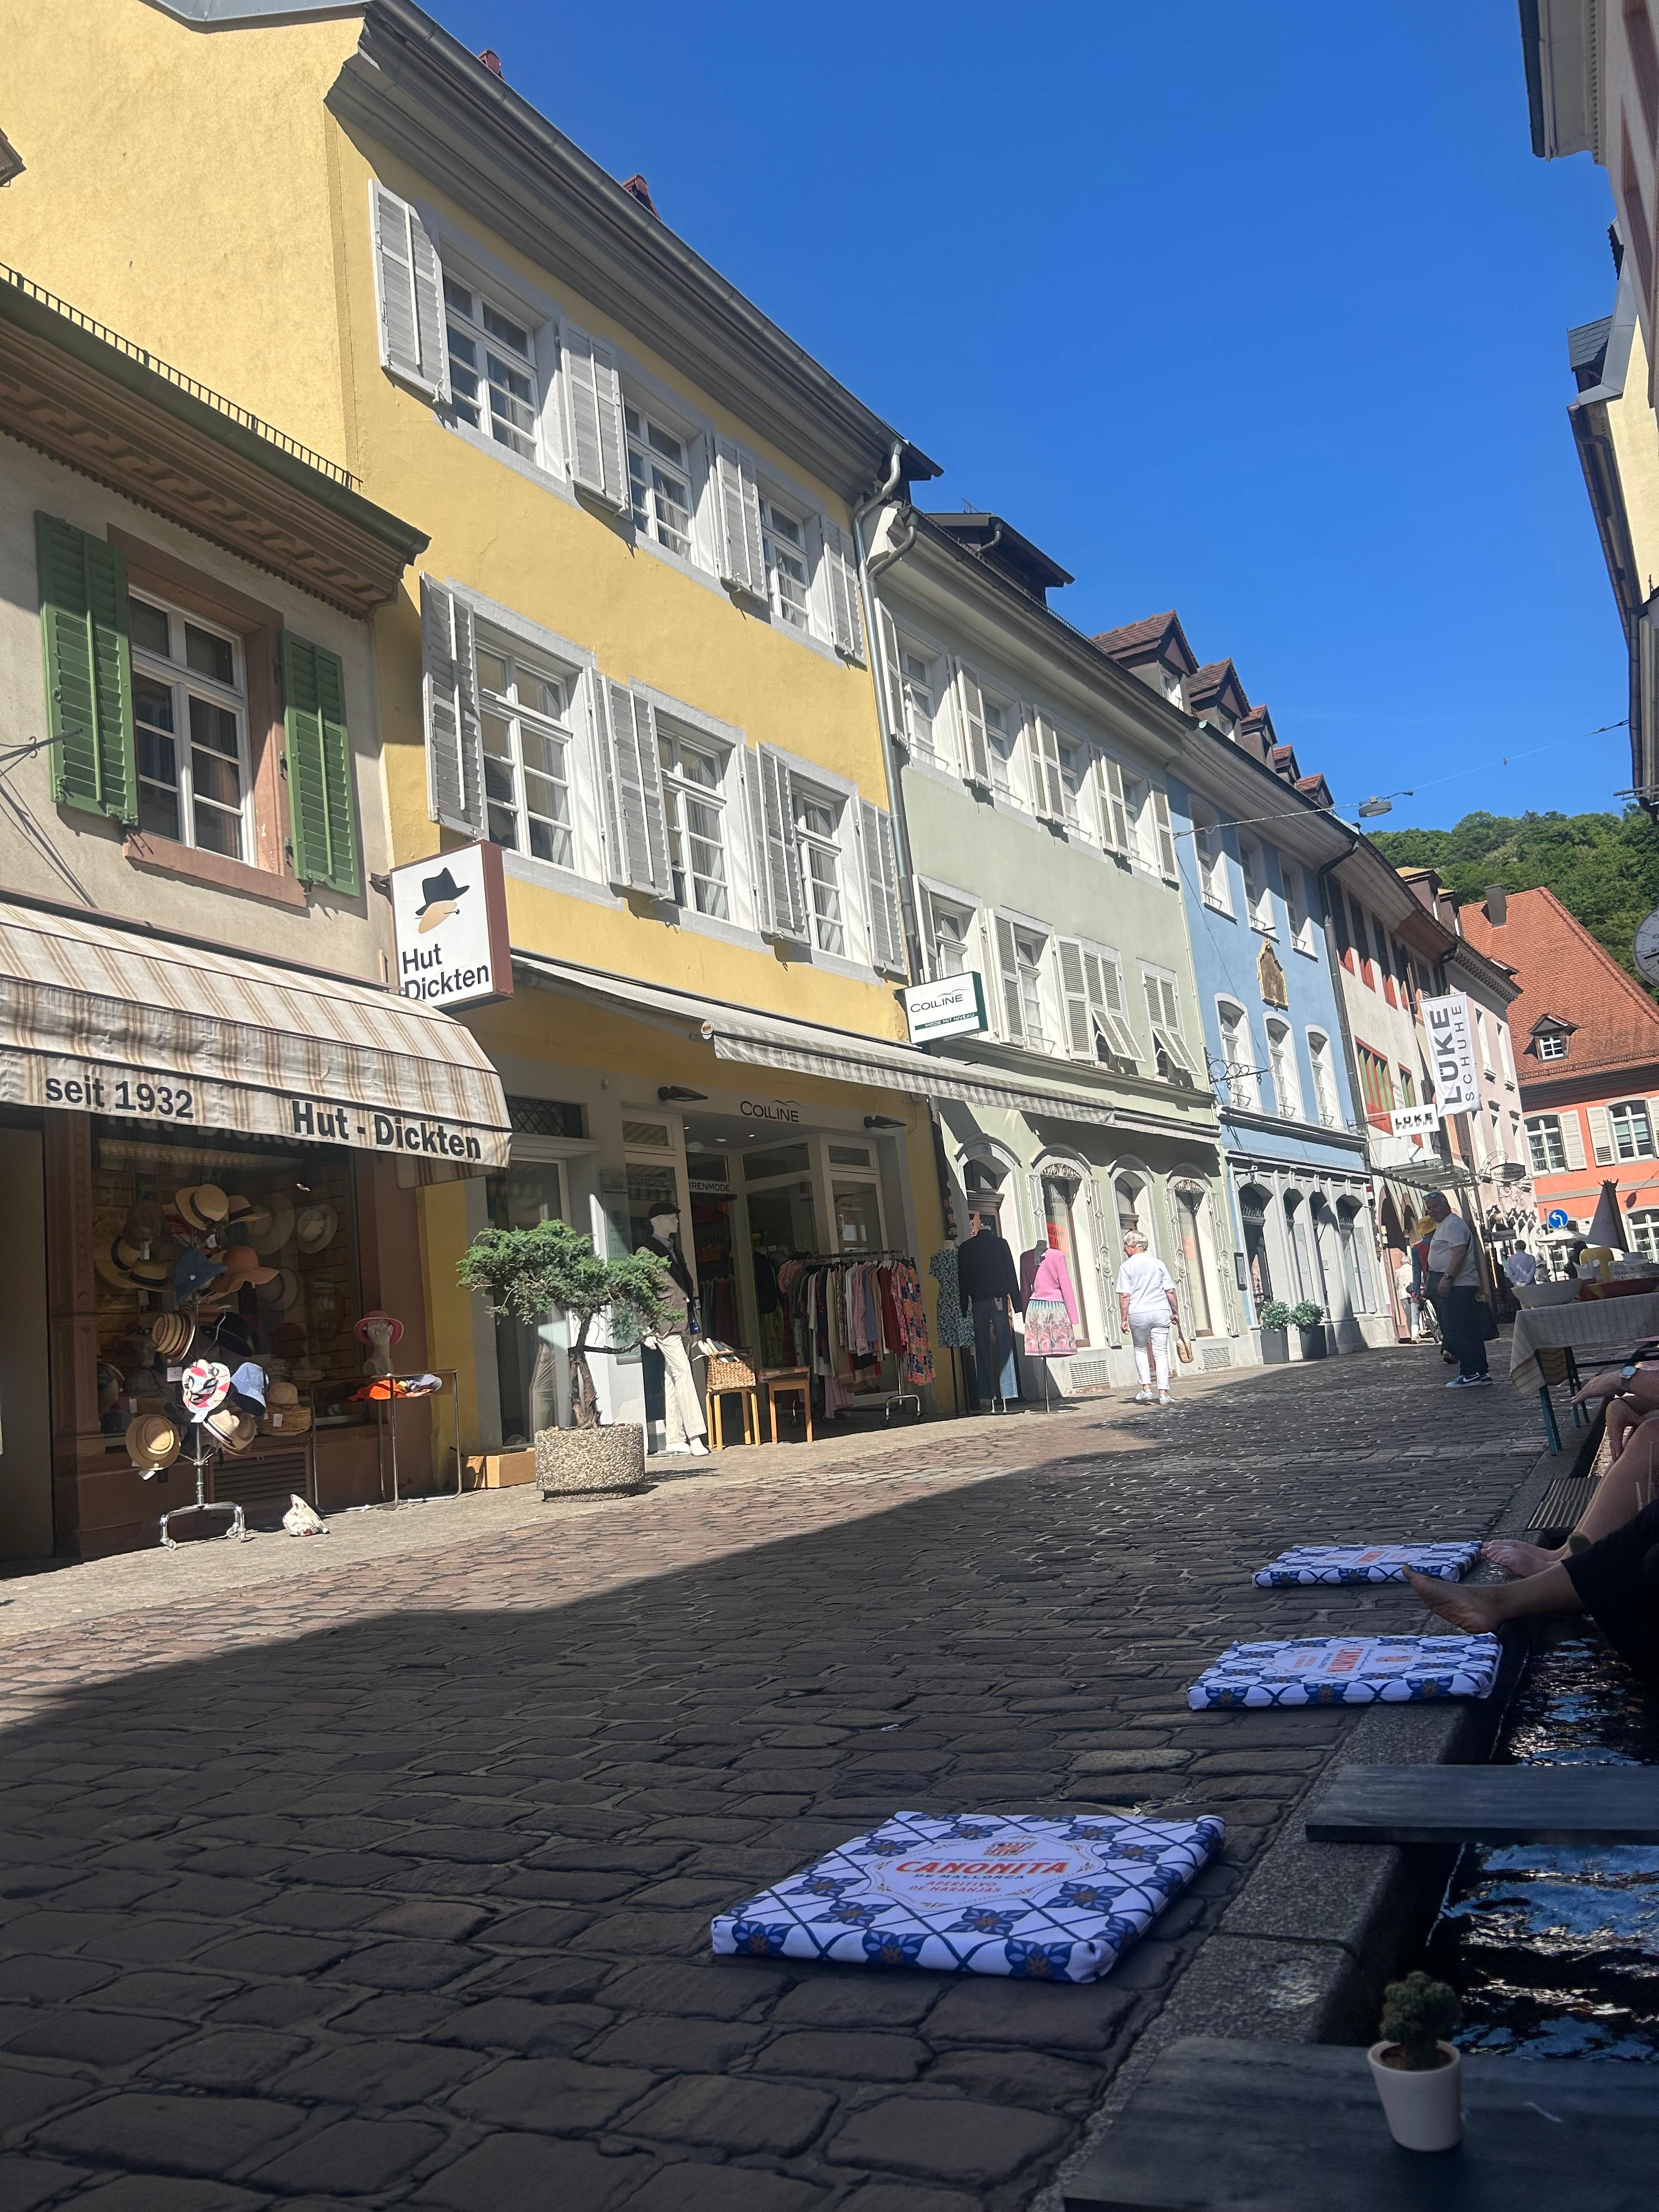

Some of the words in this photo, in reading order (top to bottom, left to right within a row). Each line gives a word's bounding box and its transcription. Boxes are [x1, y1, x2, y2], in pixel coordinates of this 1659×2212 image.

[402, 943, 443, 974] Hut
[404, 964, 489, 1000] Dickten
[910, 994, 963, 1013] COLLINE
[953, 1012, 975, 1021] NIVEAU
[1429, 1008, 1463, 1104] LÜKE
[1451, 1005, 1475, 1102] SCHUHE
[46, 1074, 105, 1108] seit
[115, 1081, 194, 1119] 1932
[740, 1101, 799, 1122] COLLINE
[292, 1100, 349, 1140] Hut
[374, 1114, 482, 1159] Dickten
[895, 1861, 1070, 1874] CANONITA
